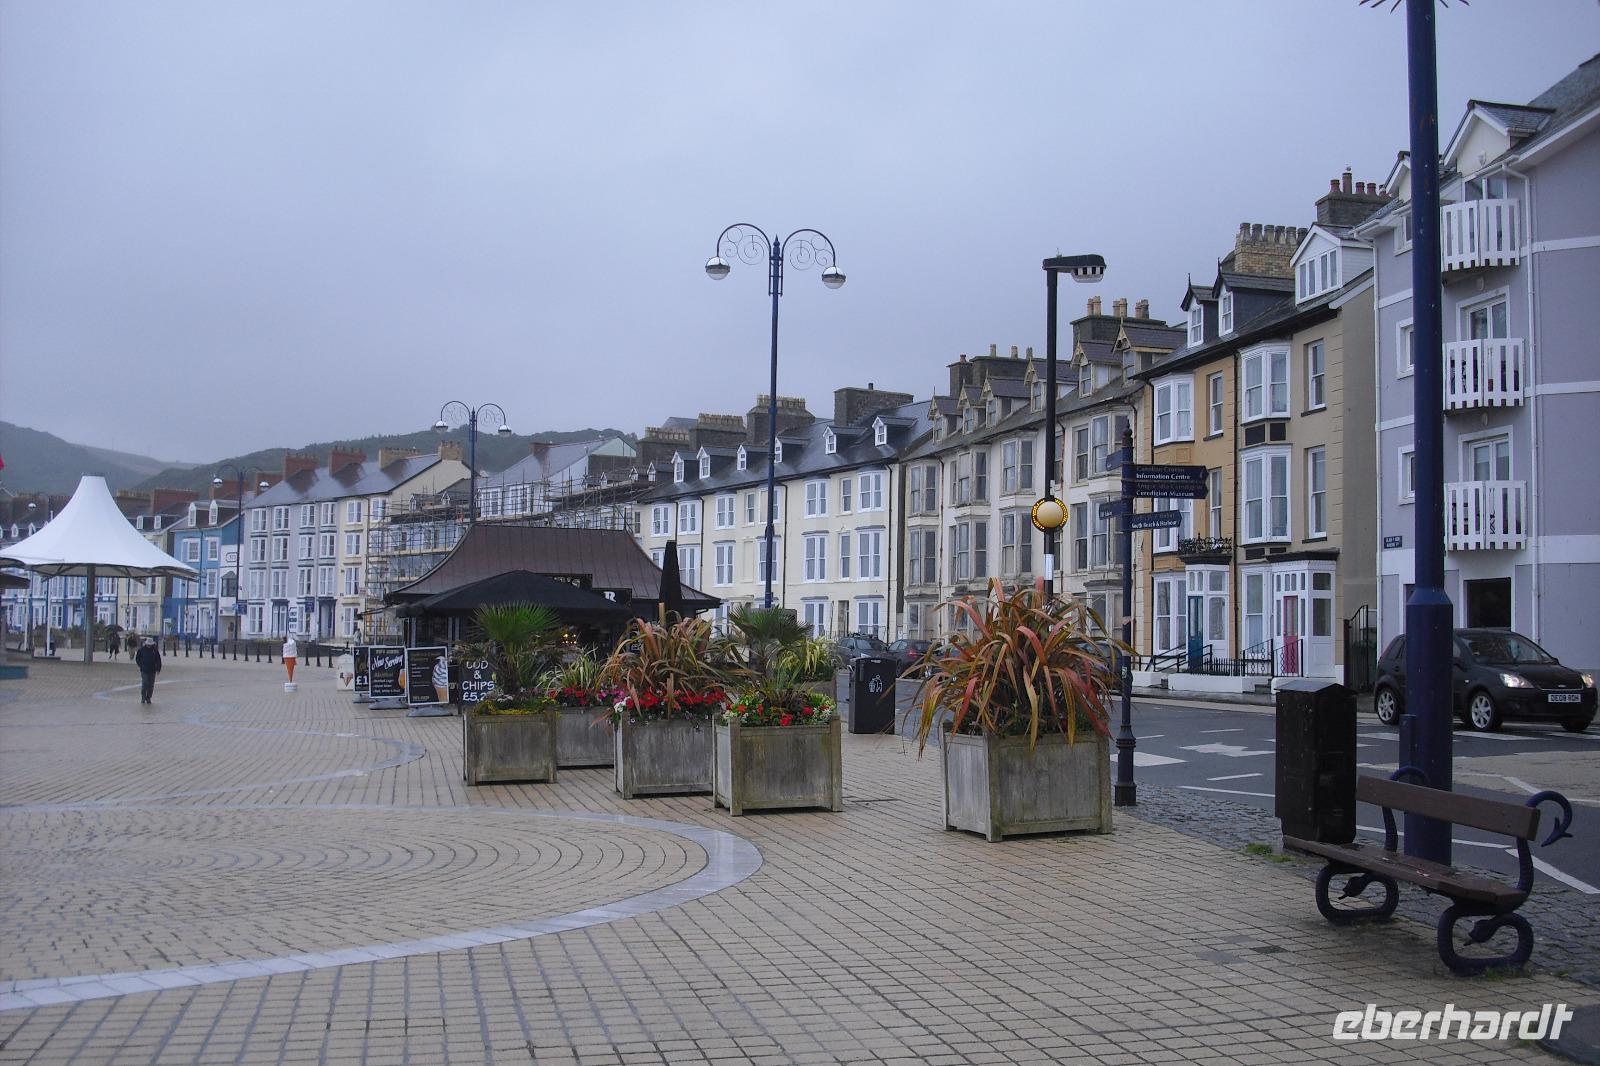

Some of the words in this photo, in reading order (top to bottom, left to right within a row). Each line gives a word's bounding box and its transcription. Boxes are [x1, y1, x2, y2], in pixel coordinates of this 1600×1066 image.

[371, 655, 385, 671] Now
[384, 654, 403, 670] Serving
[473, 670, 482, 680] &
[461, 680, 495, 691] CHIPS
